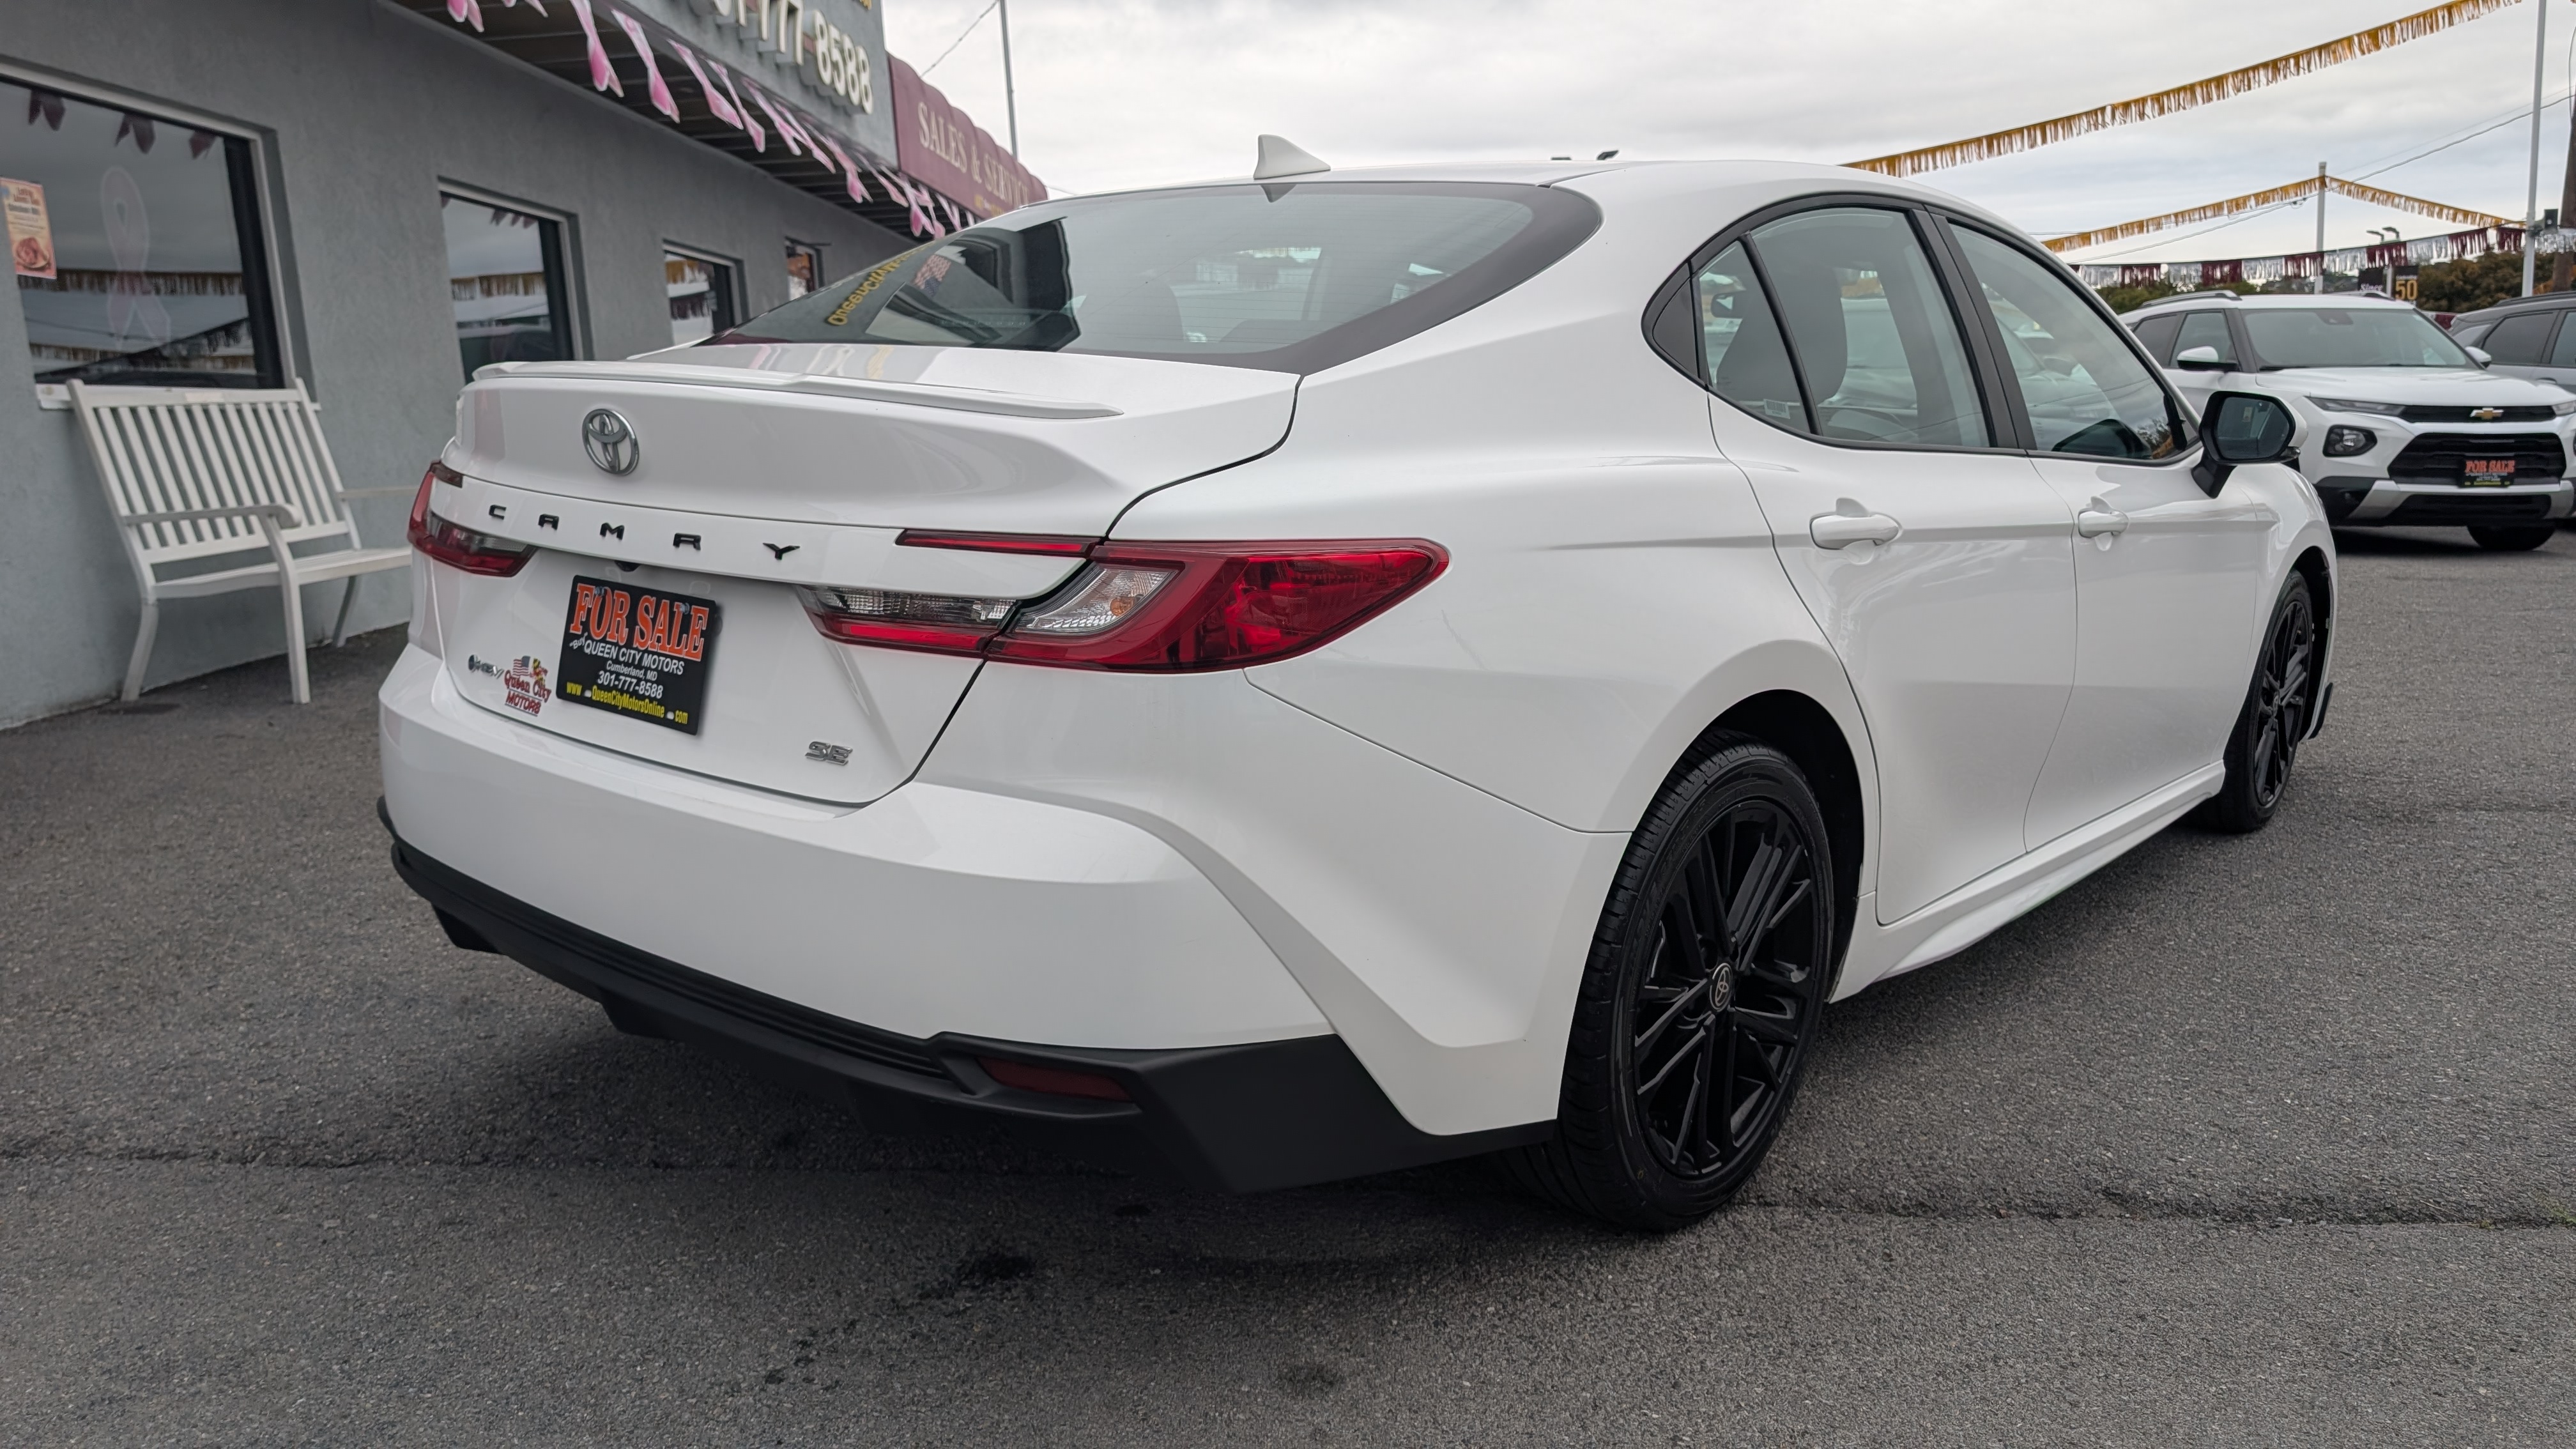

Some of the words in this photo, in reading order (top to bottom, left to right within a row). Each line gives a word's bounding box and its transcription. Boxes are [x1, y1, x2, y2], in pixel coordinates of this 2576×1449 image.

[918, 102, 967, 174] SALES
[970, 146, 982, 184] &
[2395, 279, 2418, 300] 50
[2465, 459, 2487, 473] FOR
[2488, 459, 2515, 473] SALE
[488, 503, 801, 560] CAMRY
[569, 583, 631, 646] FOR
[633, 595, 709, 662] SALE
[584, 640, 619, 660] QUEEN
[619, 647, 642, 664] CITY
[642, 654, 685, 675] MOTORS
[606, 660, 646, 680] Cumberland,
[646, 669, 657, 681] MD
[504, 670, 530, 694] Queen
[533, 679, 552, 703] City
[597, 670, 664, 699] 301-777-8588
[505, 690, 542, 714] MOTORS
[805, 740, 854, 767] SE
